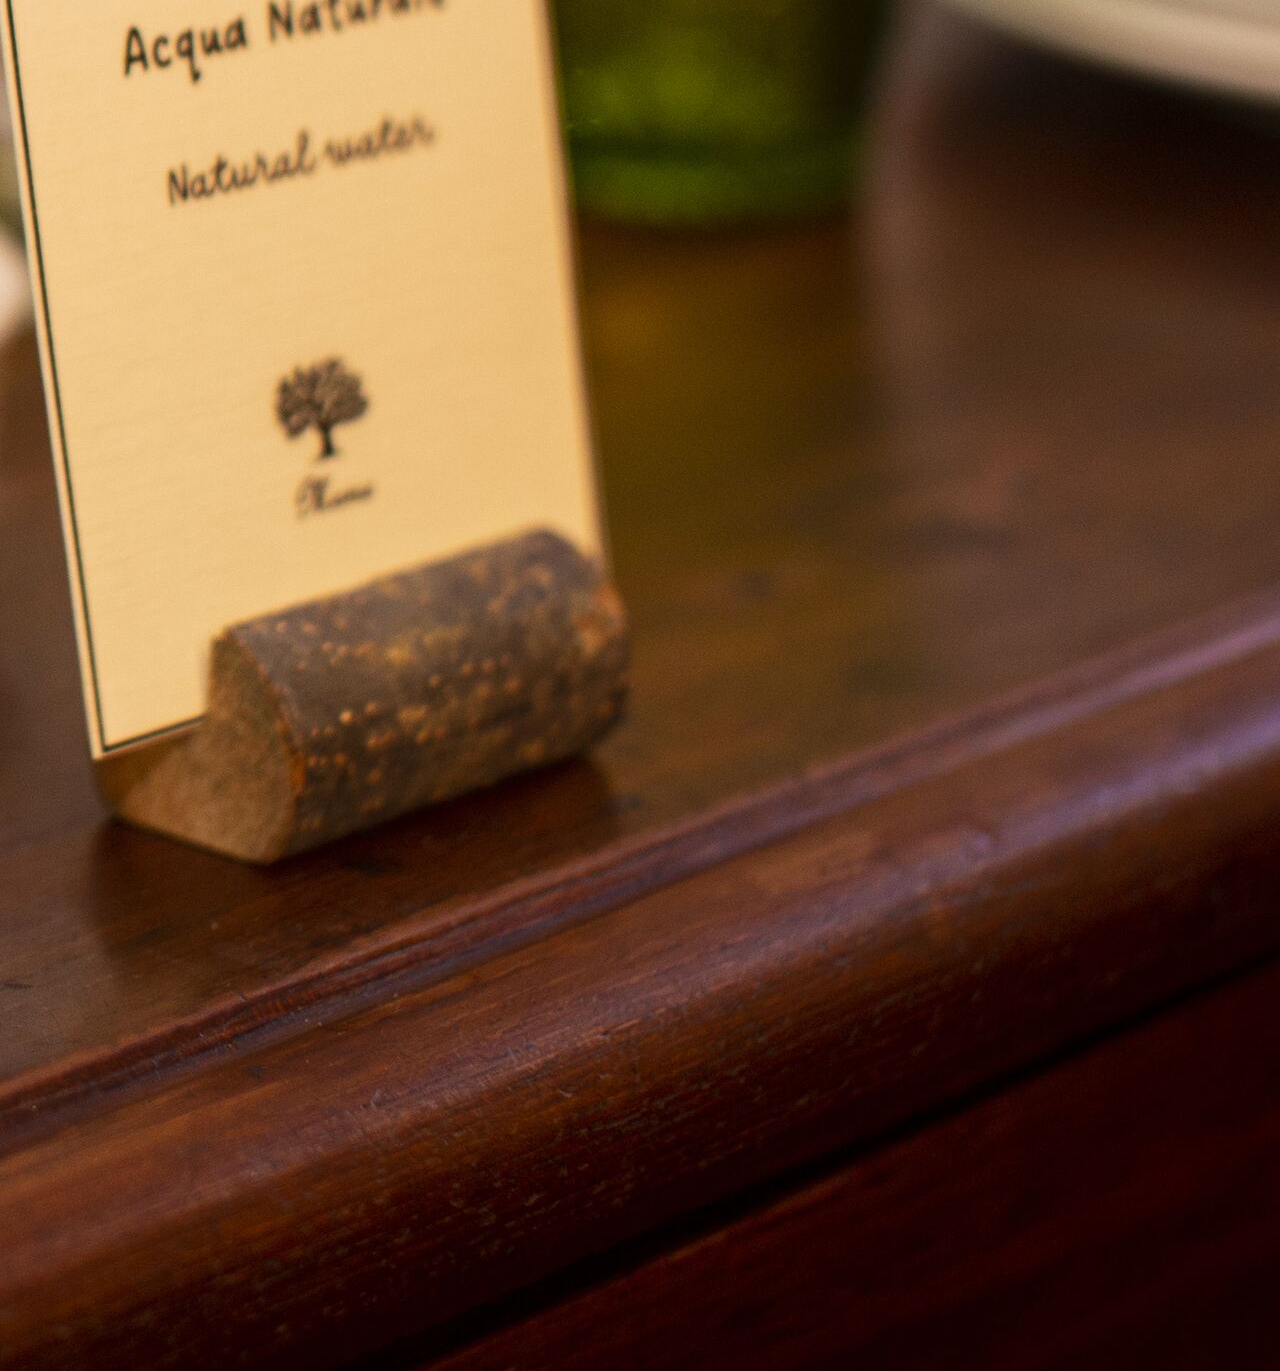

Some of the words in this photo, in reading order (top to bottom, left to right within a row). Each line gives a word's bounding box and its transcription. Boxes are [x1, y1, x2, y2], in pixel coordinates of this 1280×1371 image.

[123, 17, 248, 84] Acqua
[166, 130, 316, 206] Natural
[325, 115, 434, 167] water
